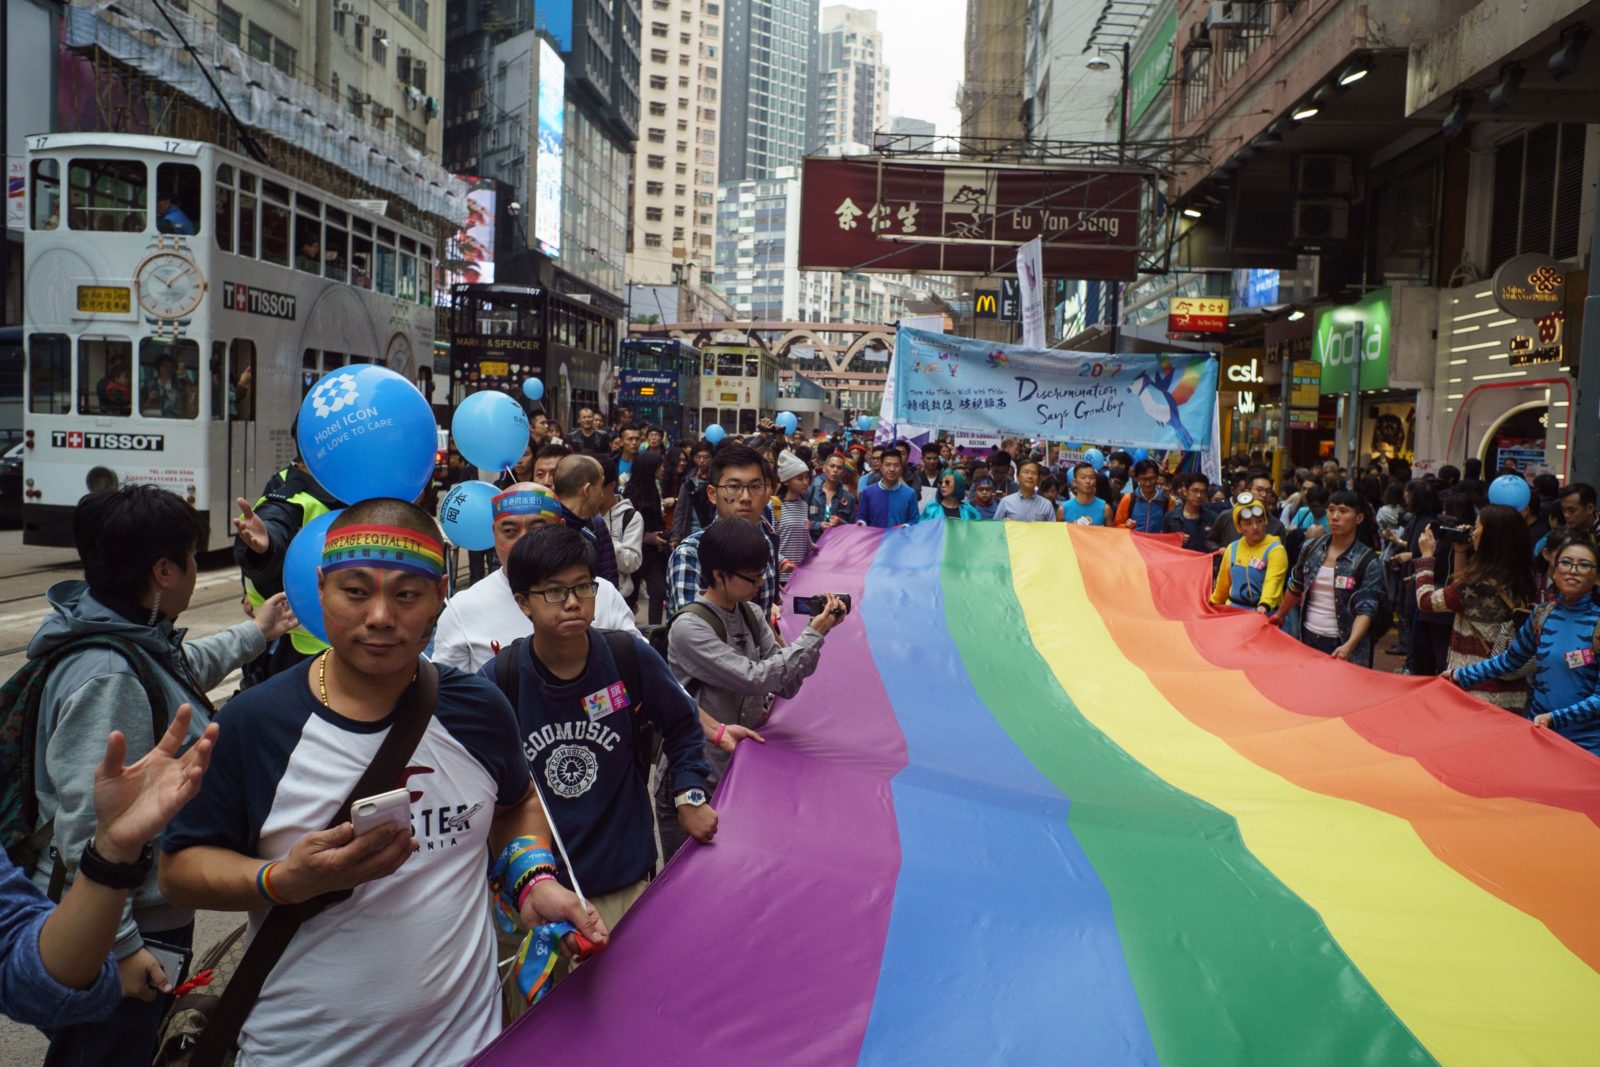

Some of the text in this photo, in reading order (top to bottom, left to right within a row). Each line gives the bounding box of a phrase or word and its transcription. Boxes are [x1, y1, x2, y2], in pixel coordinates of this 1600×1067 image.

[36, 137, 48, 149] 17
[165, 141, 180, 153] 17
[834, 197, 920, 233] 余仁生
[1012, 209, 1120, 237] Eu Yan Sang
[526, 287, 540, 295] 107
[248, 288, 295, 319] TISSOT
[486, 339, 493, 347] &
[495, 339, 540, 350] SPENCER
[1318, 323, 1382, 368] Voda
[632, 376, 653, 384] NIPPON
[1078, 361, 1123, 379] 2017
[1014, 376, 1118, 402] Discrimination
[314, 406, 379, 445] Hotel ICON
[1035, 403, 1069, 429] Says
[86, 433, 162, 450] TISSOT
[327, 432, 350, 451] LOVE
[351, 426, 365, 437] TO
[367, 418, 394, 431] CARE
[364, 533, 423, 552] EQUALITY
